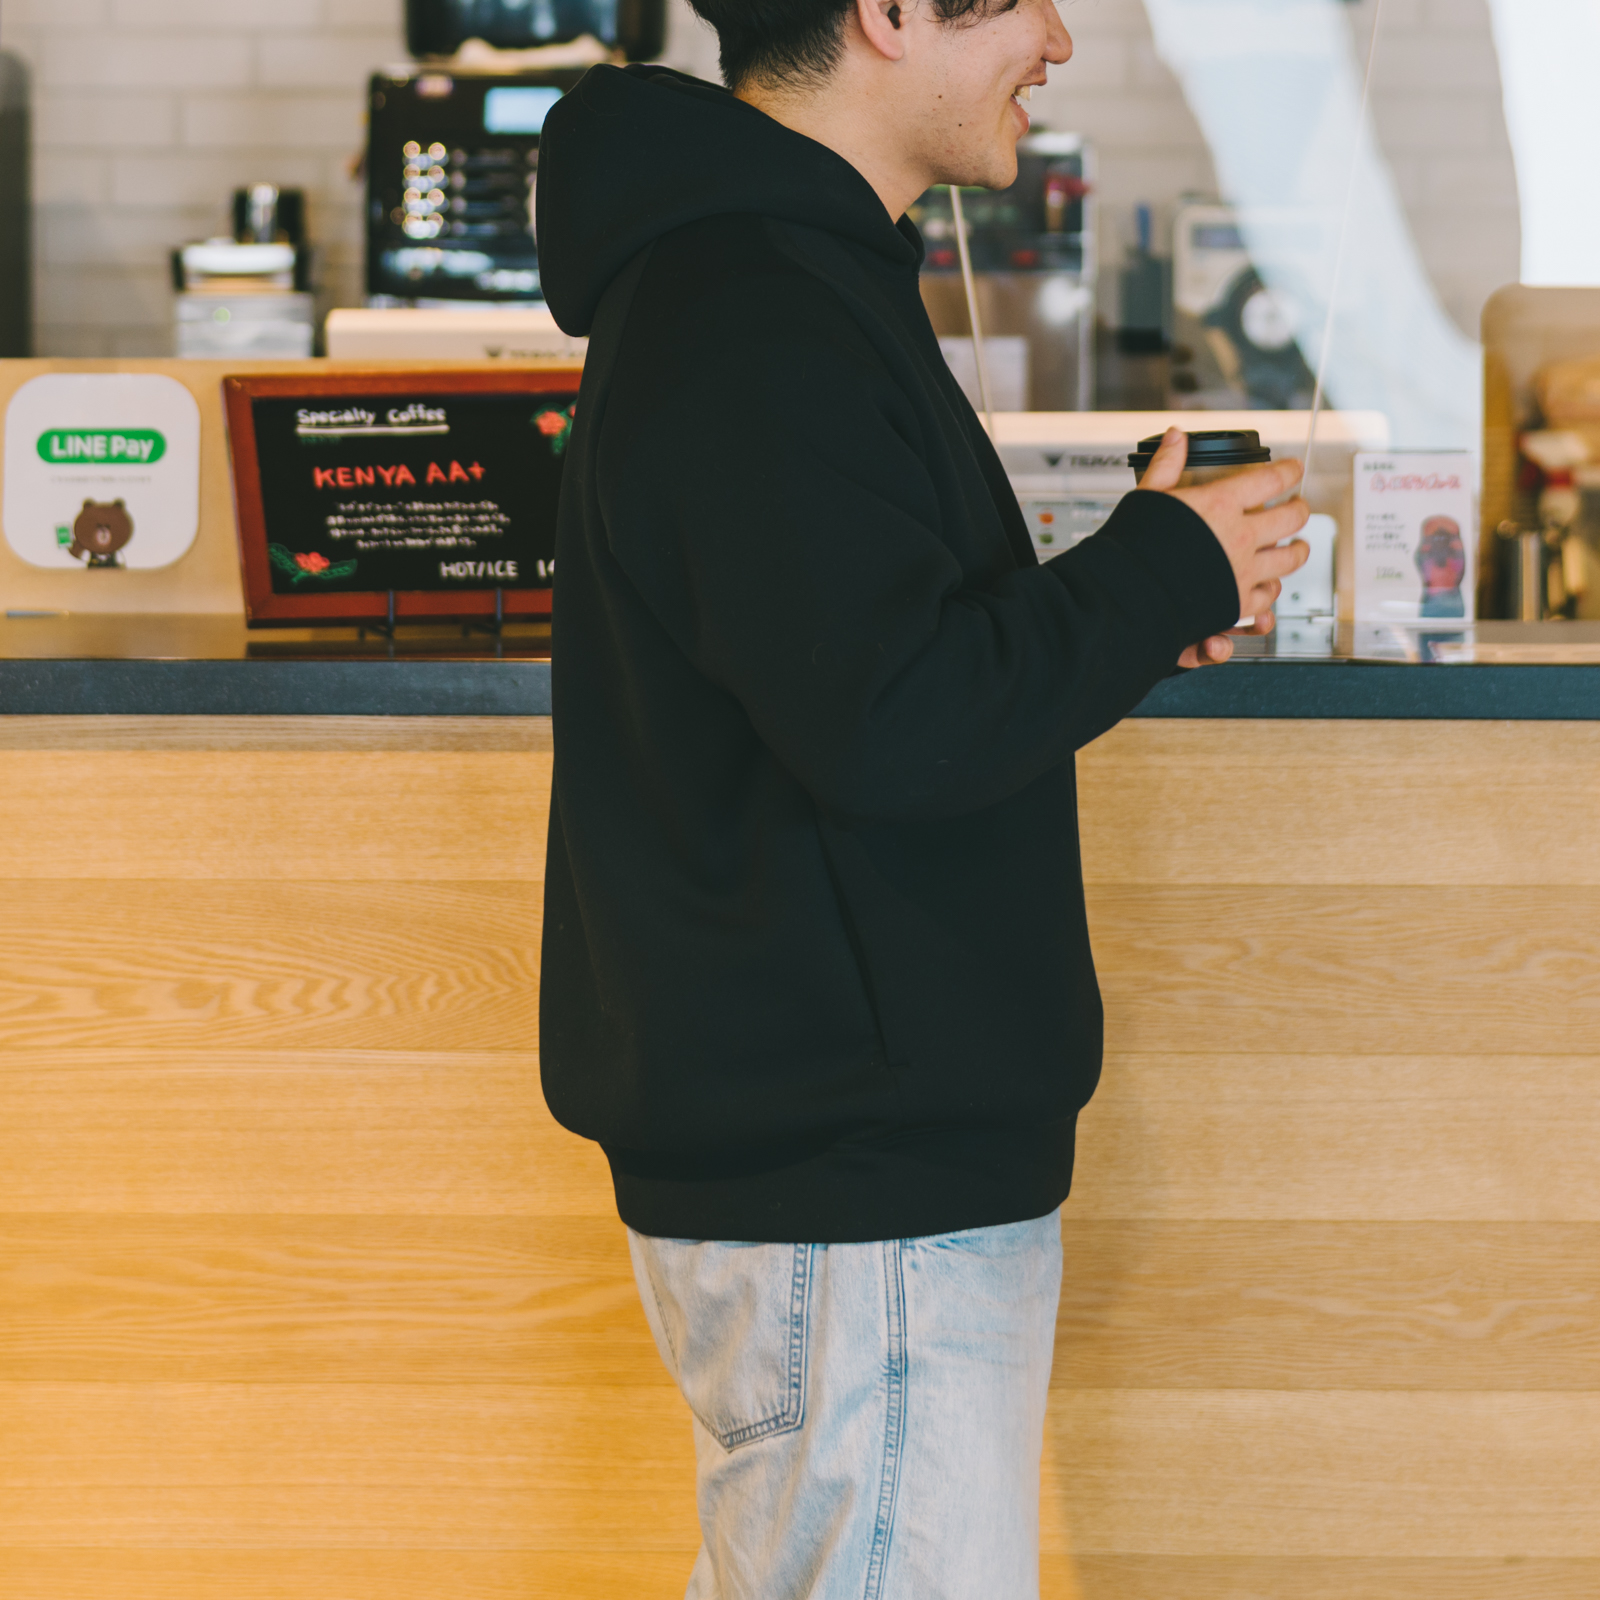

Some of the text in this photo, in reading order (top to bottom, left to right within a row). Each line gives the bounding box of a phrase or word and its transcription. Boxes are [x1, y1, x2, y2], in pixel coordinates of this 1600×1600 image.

[297, 403, 447, 426] Specialty Coffee
[52, 435, 155, 462] LINE Pay
[313, 459, 487, 489] KENYA AA+
[441, 560, 519, 579] HOT/ICE
